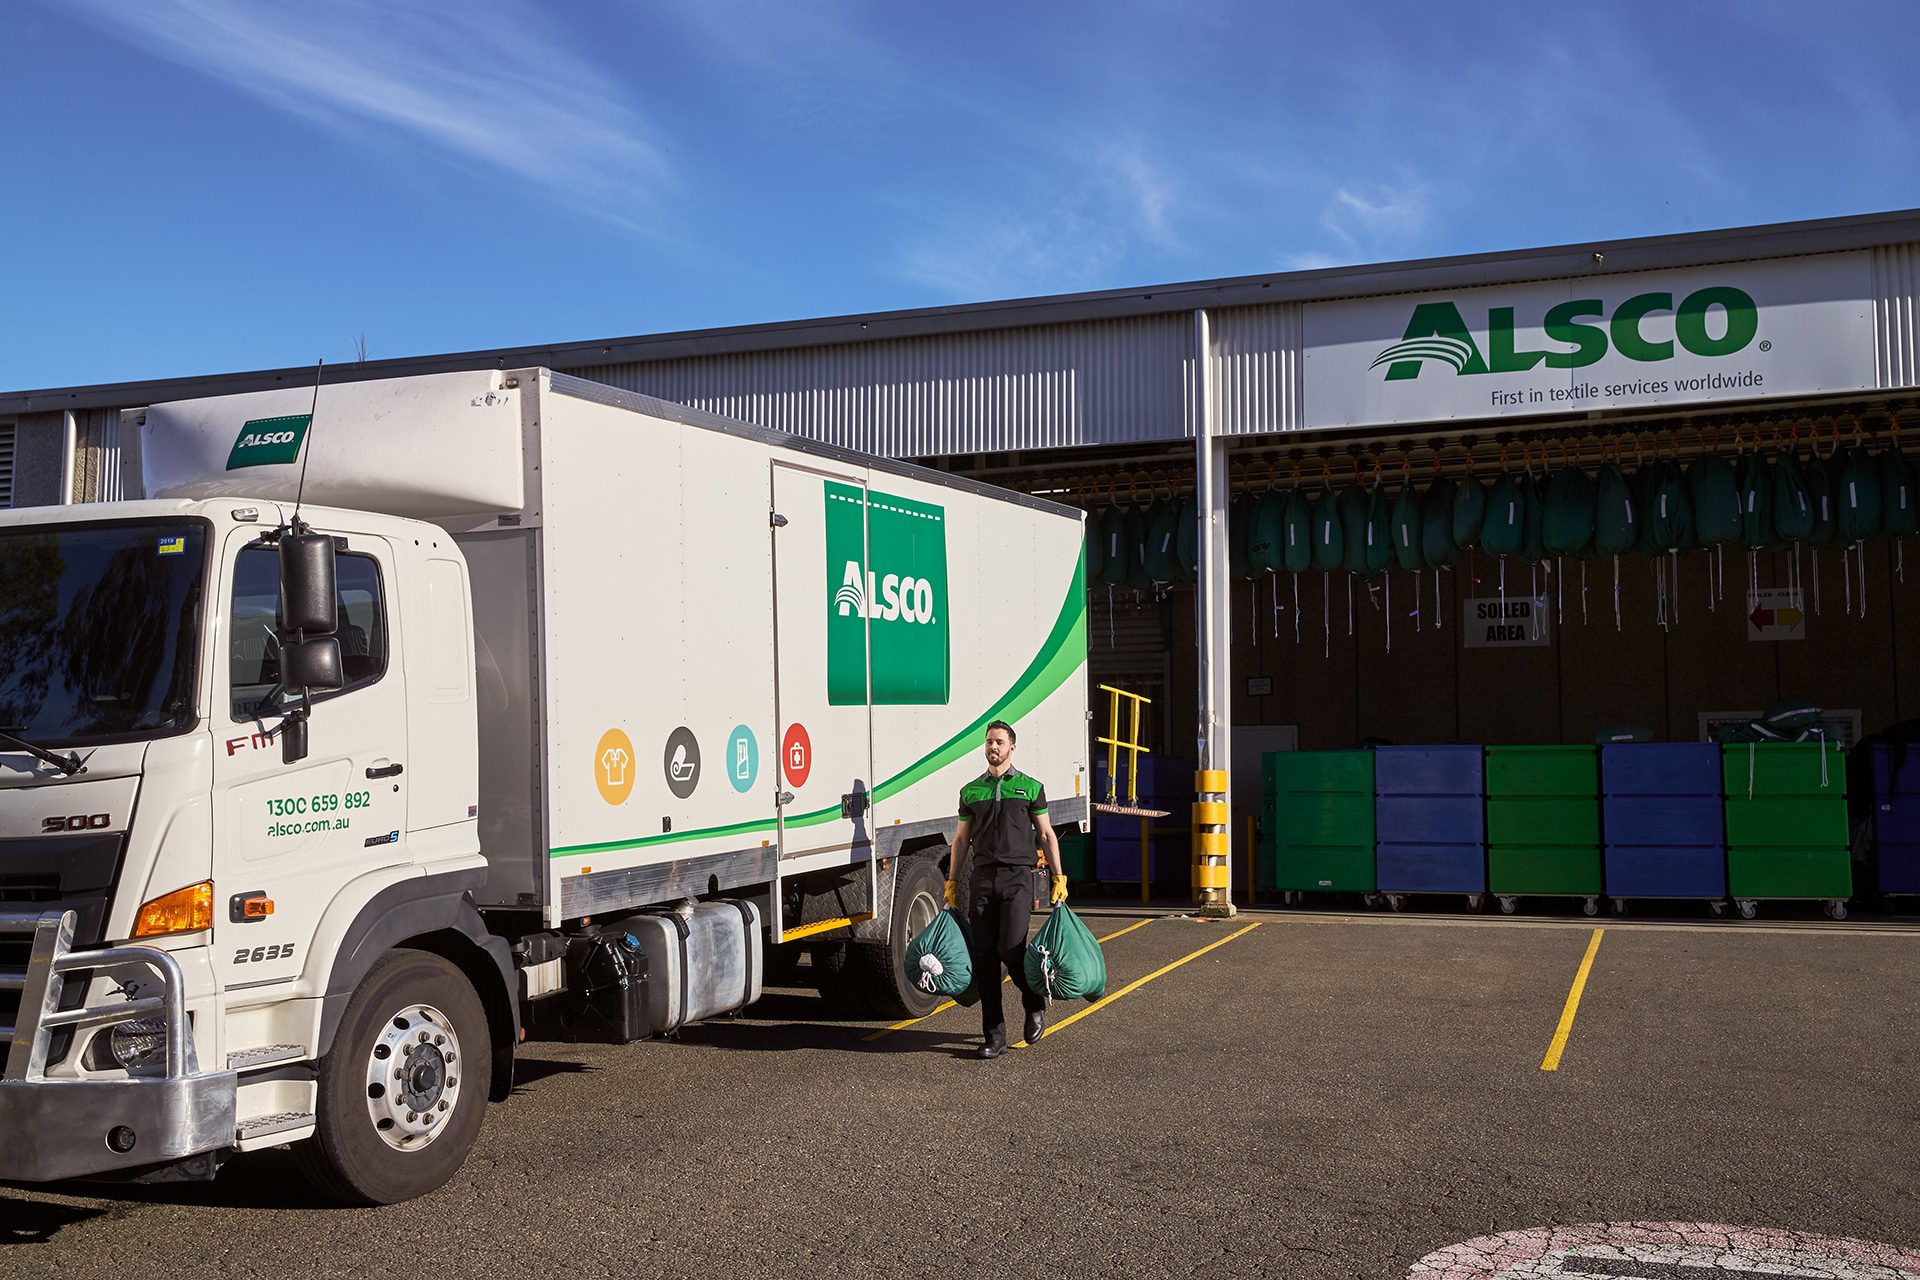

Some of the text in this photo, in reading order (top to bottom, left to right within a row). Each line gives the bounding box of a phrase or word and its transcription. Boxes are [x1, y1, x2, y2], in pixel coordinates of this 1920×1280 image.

[1491, 370, 1764, 406] First in textile services worldwide
[238, 431, 295, 449] ALSCO
[833, 560, 934, 625] ALSCO
[1477, 602, 1530, 619] SOILED
[1486, 625, 1526, 641] AREA
[311, 793, 339, 813] 659
[344, 791, 370, 809] 892
[41, 813, 111, 833] 500
[233, 943, 295, 964] 2635
